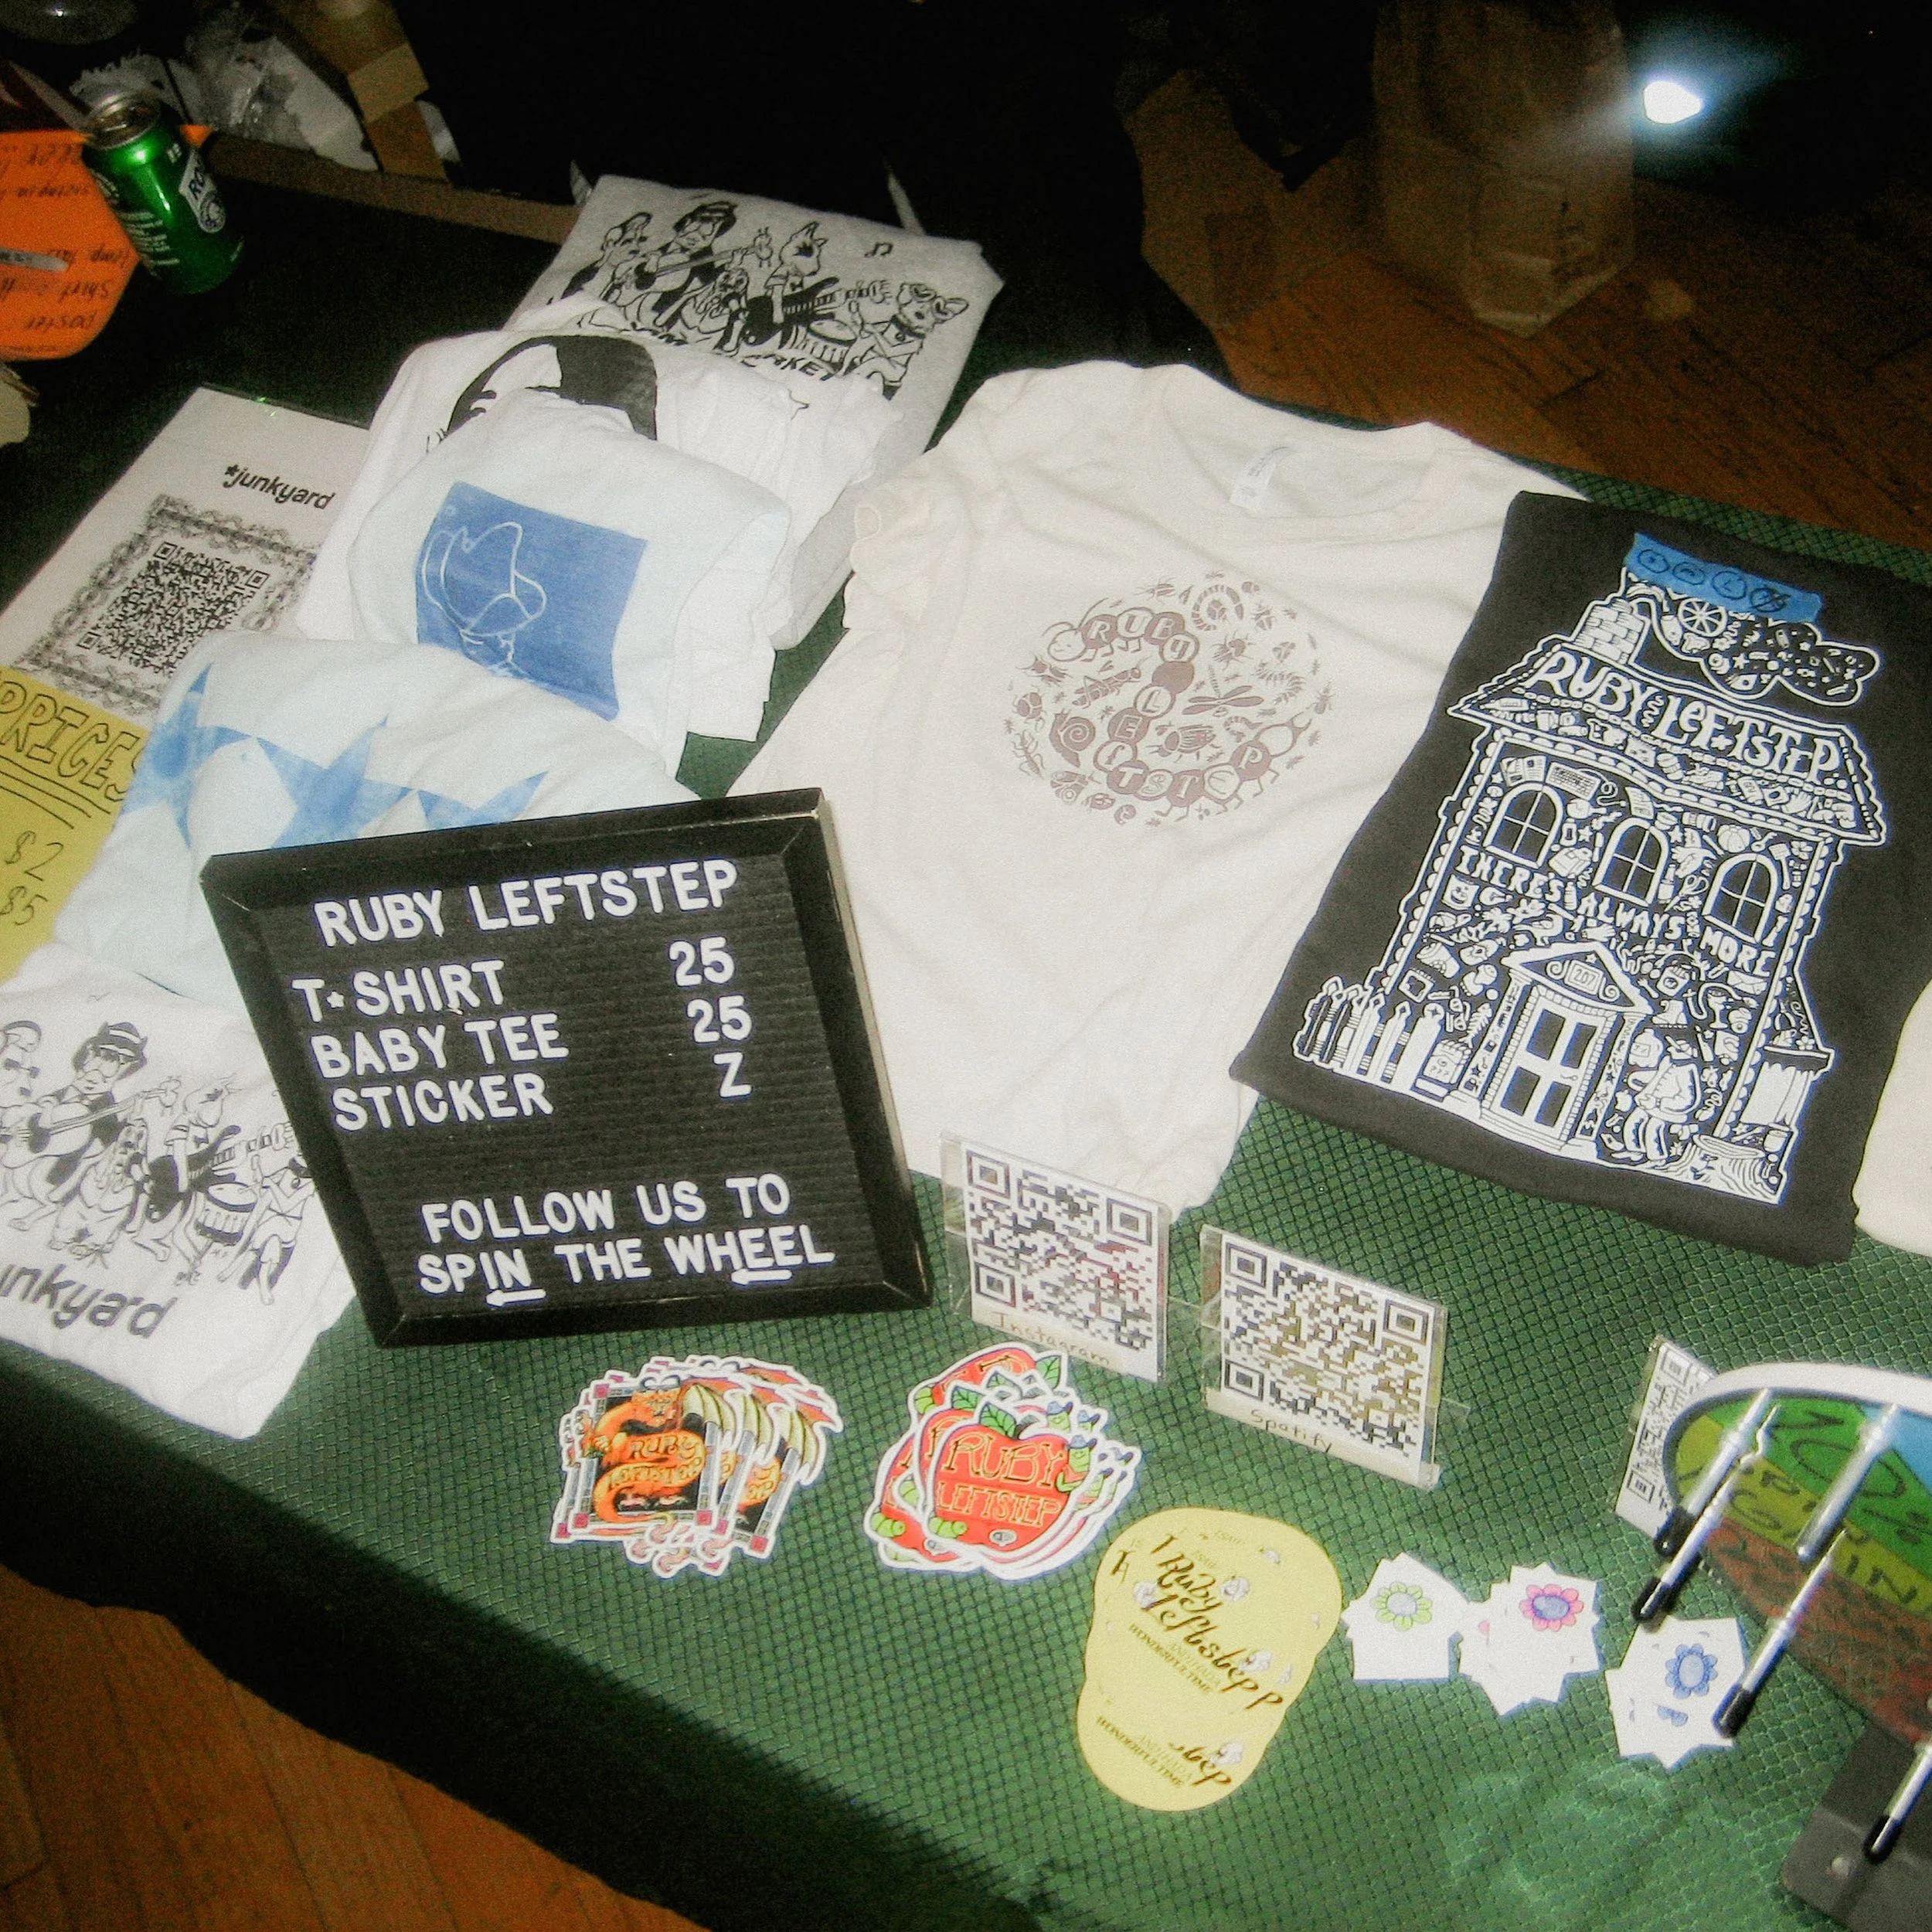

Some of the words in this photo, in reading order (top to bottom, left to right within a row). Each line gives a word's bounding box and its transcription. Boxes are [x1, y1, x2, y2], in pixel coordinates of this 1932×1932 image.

[1523, 651, 1659, 726] RUBY
[313, 889, 444, 948] RUBY
[468, 858, 738, 931] LEFTSTEP
[1578, 892, 1685, 940] ALWAYS
[1700, 927, 1776, 977] MORE
[668, 936, 735, 988] 25
[310, 1024, 447, 1079] BABY
[464, 1012, 569, 1065] TEE
[686, 995, 753, 1043] 25
[332, 1072, 554, 1131] STICKER
[421, 1189, 616, 1244] FOLLOW
[635, 1179, 708, 1226] US
[725, 1172, 792, 1219] TO
[417, 1247, 532, 1294] SPIN
[554, 1238, 652, 1284] THE
[663, 1223, 835, 1276] WHEEL
[941, 1432, 1064, 1488] RUBY
[1250, 1409, 1333, 1454] Spotify
[936, 1481, 1062, 1528] LEFTSTEP
[1157, 1553, 1224, 1613] Ruby
